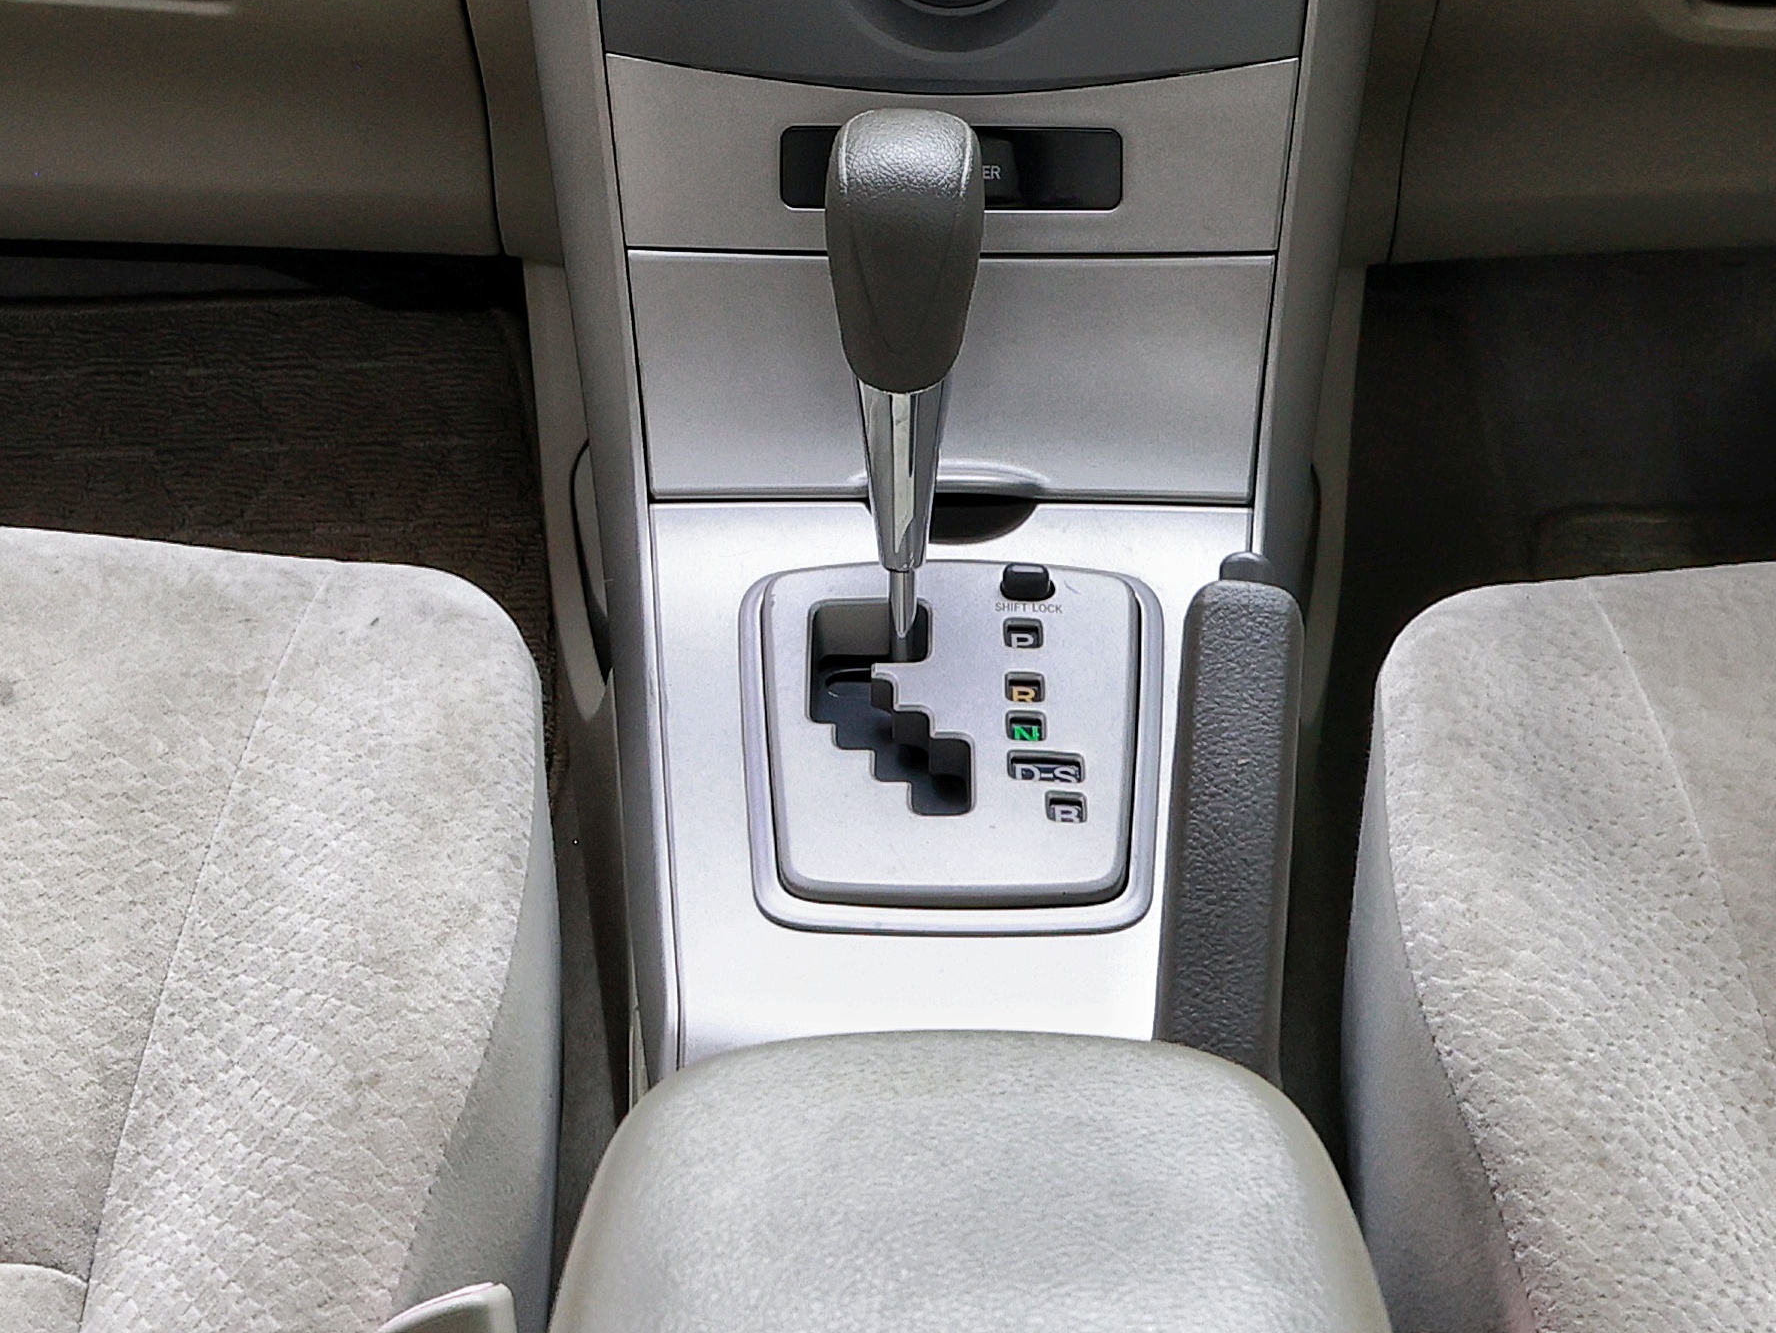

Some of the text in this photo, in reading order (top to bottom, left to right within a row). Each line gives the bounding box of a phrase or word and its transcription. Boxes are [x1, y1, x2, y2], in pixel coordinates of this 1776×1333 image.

[982, 165, 1001, 180] ER
[995, 602, 1063, 614] SHIFT LOCK
[1011, 634, 1034, 648] P
[1012, 686, 1035, 702] R
[1014, 726, 1040, 741] N
